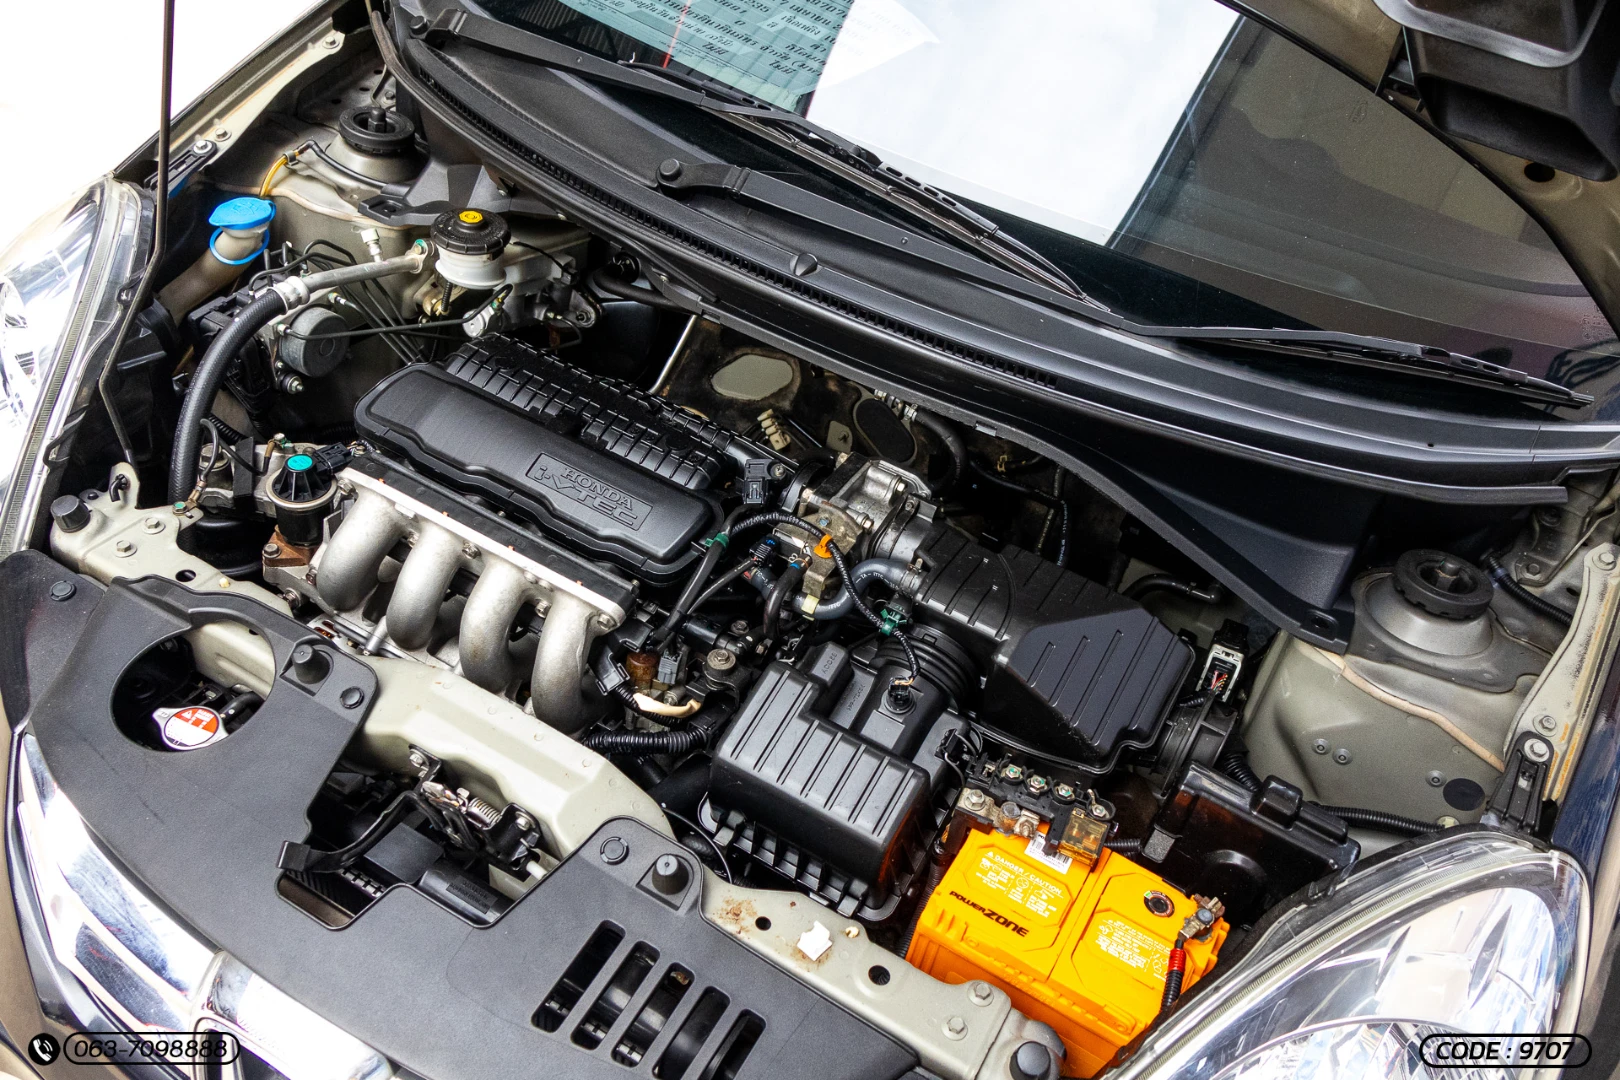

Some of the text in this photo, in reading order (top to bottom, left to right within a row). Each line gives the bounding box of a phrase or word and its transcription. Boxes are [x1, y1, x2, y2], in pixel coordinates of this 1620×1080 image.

[533, 465, 639, 527] i-VTEC
[560, 467, 634, 511] HONDA
[994, 854, 1025, 874] DANGER
[1029, 874, 1063, 896] CAUTION
